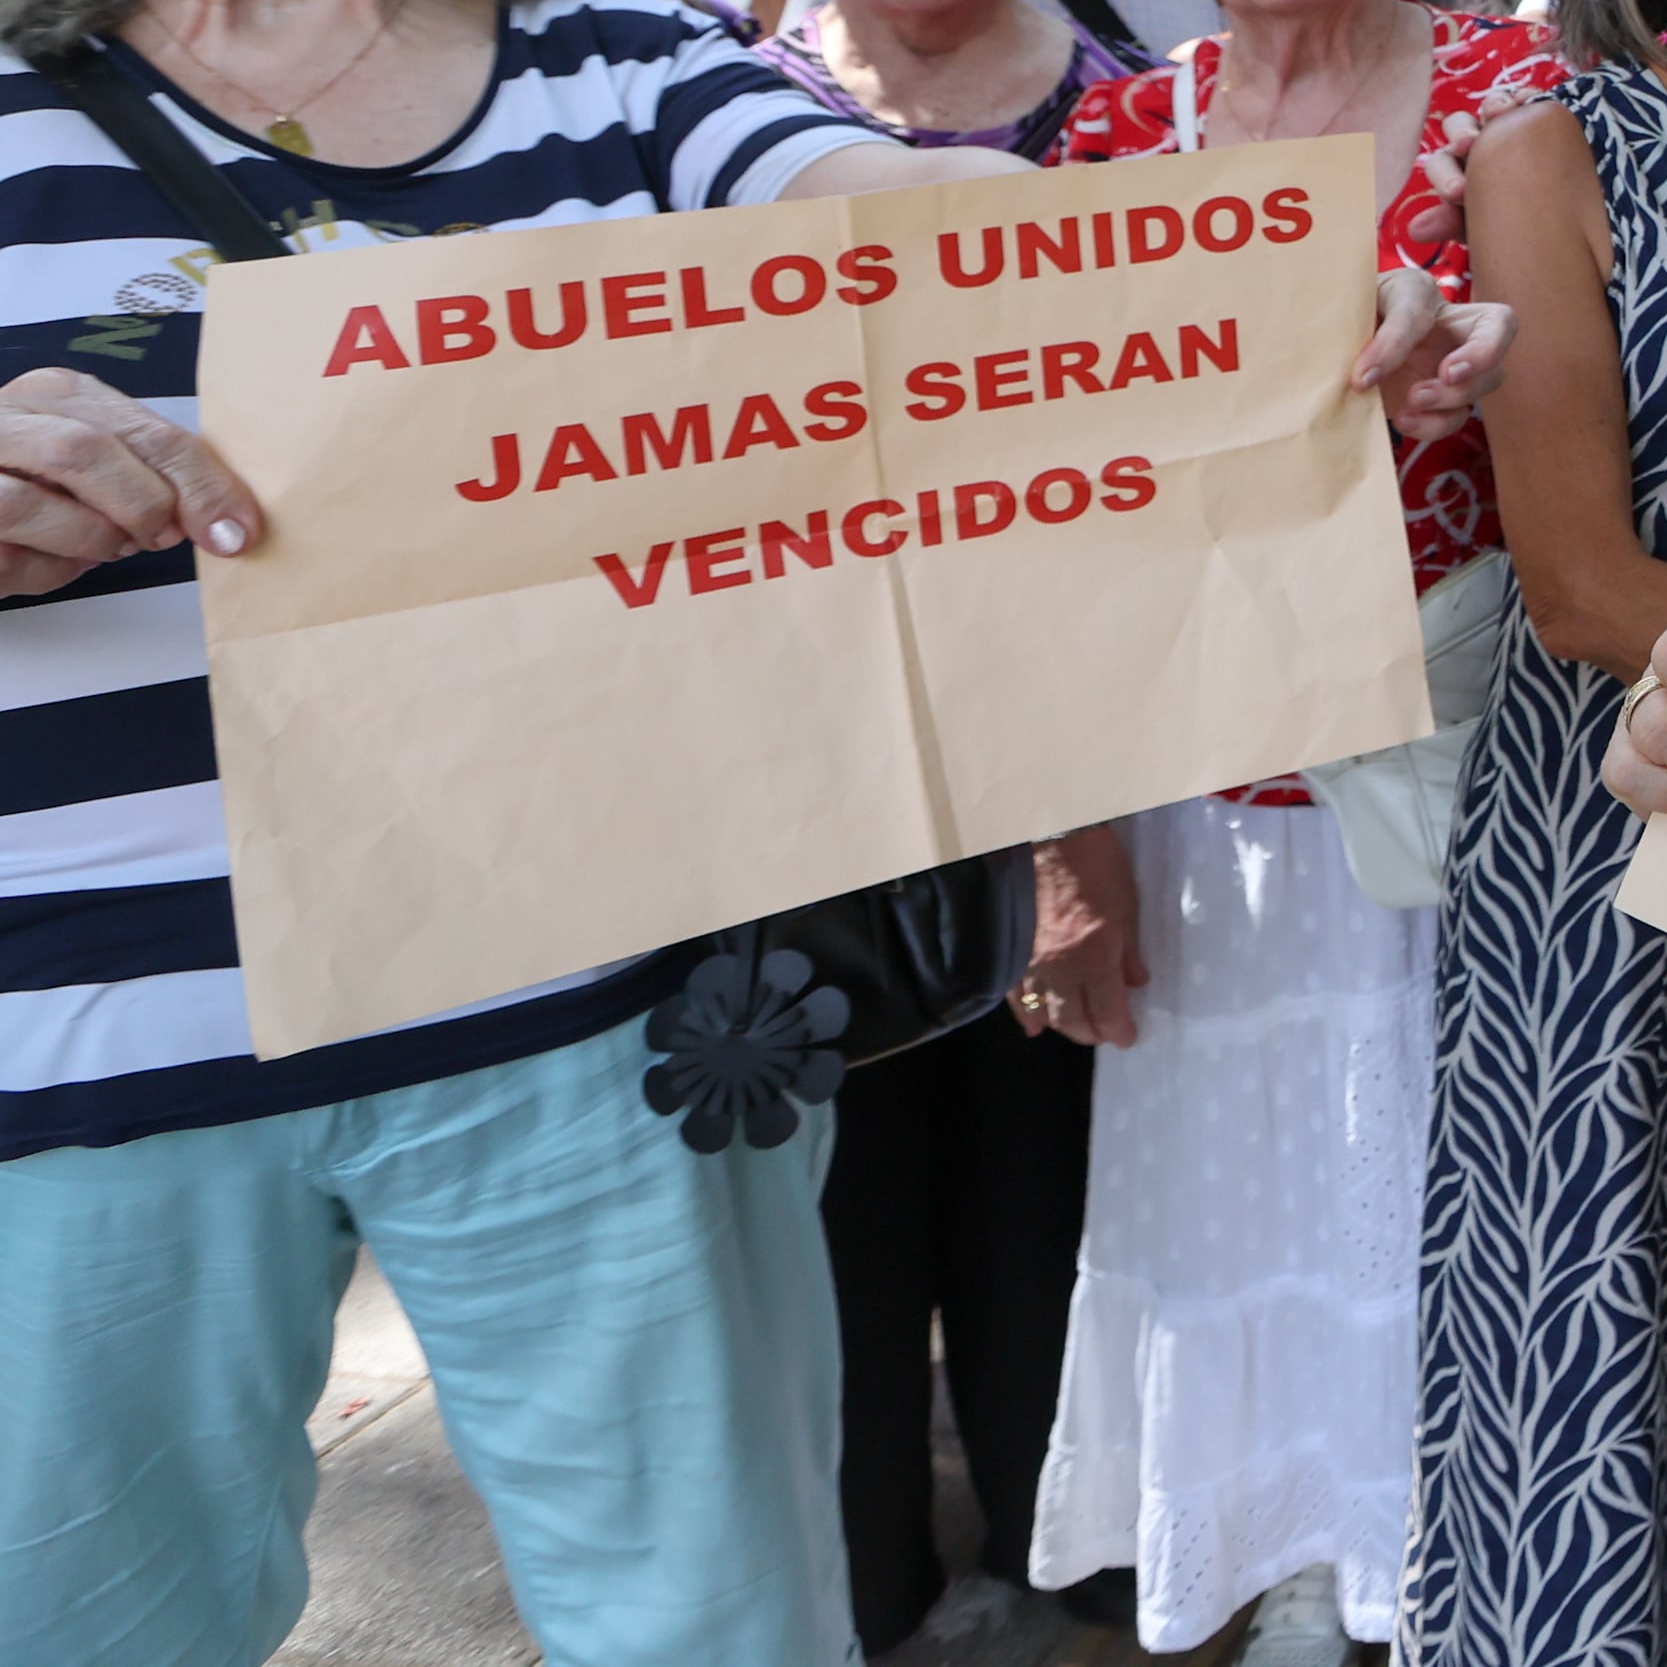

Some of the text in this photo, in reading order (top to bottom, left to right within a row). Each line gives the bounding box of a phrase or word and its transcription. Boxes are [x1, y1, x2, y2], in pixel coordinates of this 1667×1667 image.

[323, 186, 1314, 378] ABUELOS UNIDOS
[455, 318, 1240, 502] JAMAS SERAN
[594, 455, 1158, 610] VENCIDOS
